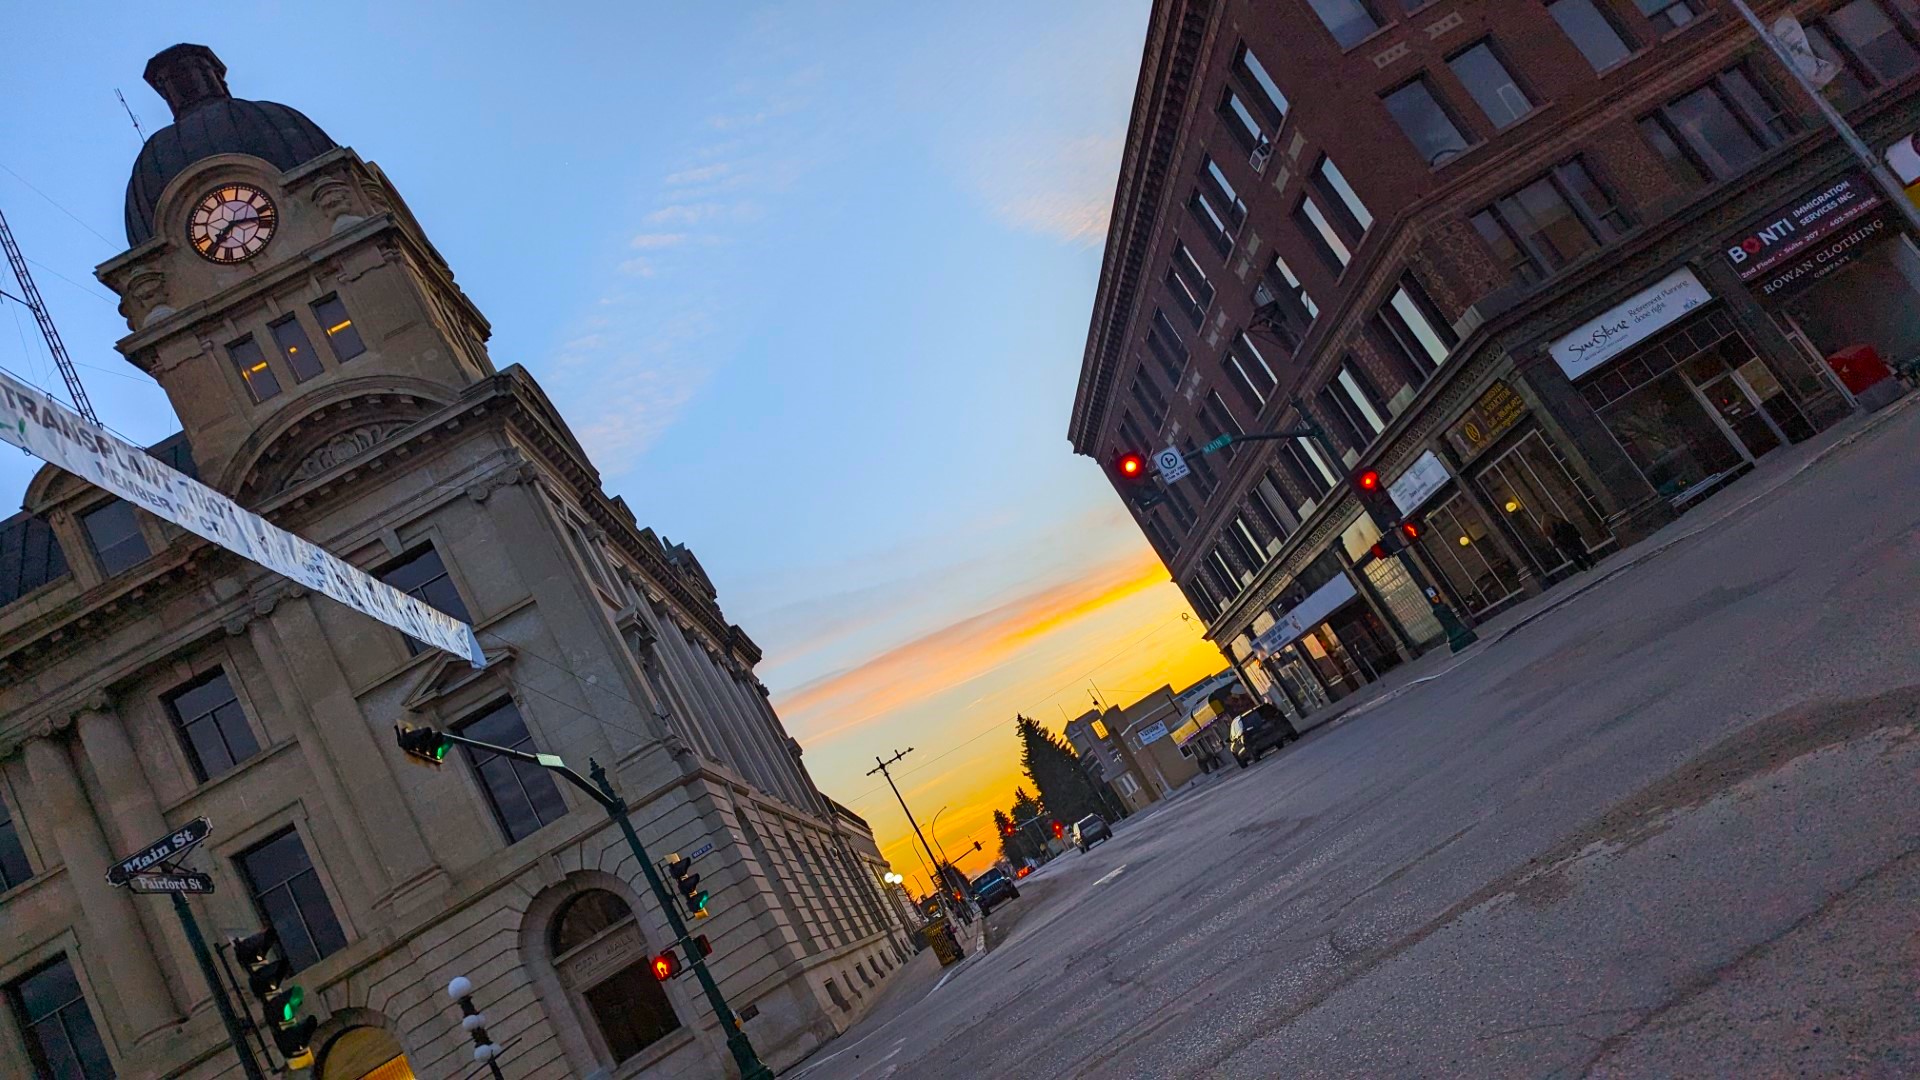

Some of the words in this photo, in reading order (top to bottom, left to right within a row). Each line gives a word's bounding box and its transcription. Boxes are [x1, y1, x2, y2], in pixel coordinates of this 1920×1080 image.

[1792, 180, 1850, 218] IMMIGRATION
[1799, 200, 1838, 226] SERVICES
[1837, 191, 1856, 205] INC.
[1741, 266, 1757, 279] 2nd
[1756, 256, 1776, 270] Floor
[1763, 260, 1814, 295] ROWAN
[1816, 218, 1884, 263] CLOTHING
[1813, 255, 1850, 279] COMPANY
[1627, 293, 1663, 317] Retirement
[1660, 279, 1690, 298] Planning
[1633, 310, 1651, 324] done
[1650, 301, 1667, 316] right
[0, 382, 174, 493] TRANSPLANT
[95, 460, 176, 514] MEMBER
[122, 844, 171, 873] Main
[171, 829, 194, 849] St
[137, 877, 187, 890] Fairford
[188, 878, 203, 890] St
